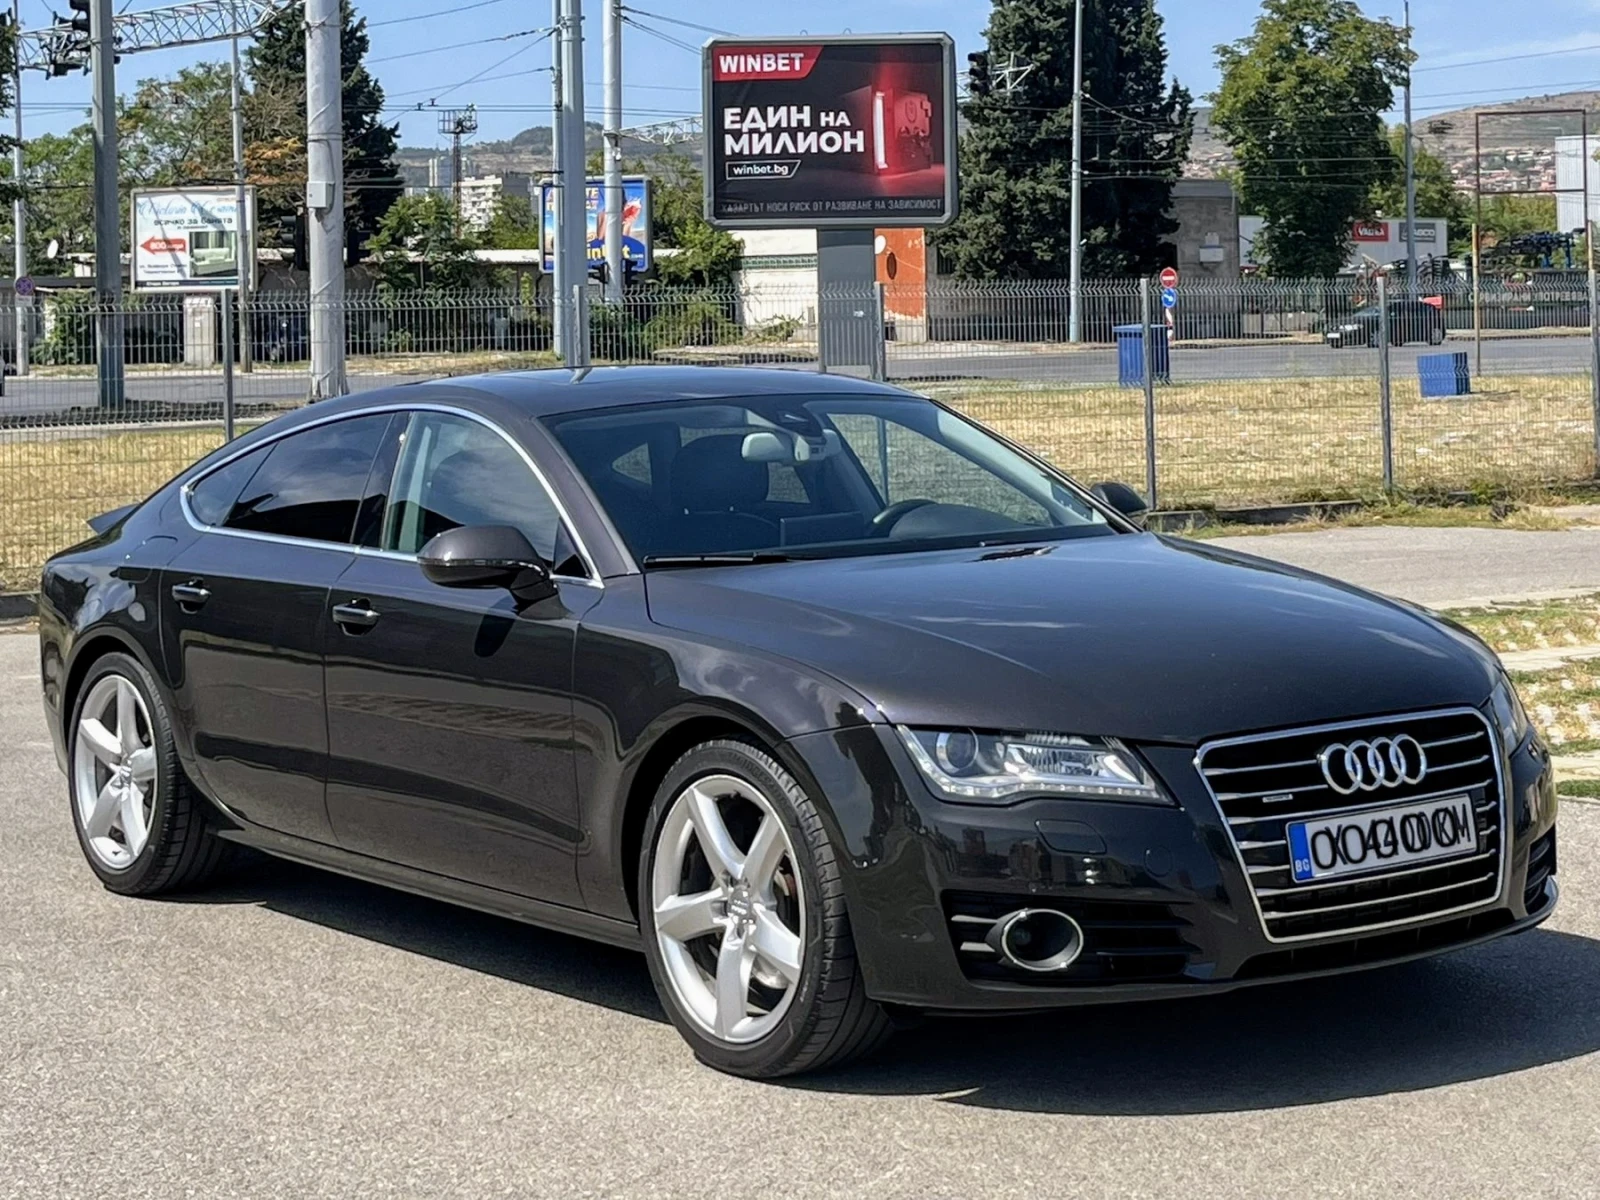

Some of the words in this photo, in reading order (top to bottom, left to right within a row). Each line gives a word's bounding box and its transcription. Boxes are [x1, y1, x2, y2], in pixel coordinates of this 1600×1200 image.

[719, 52, 804, 74] WINBET
[723, 105, 811, 133] ЕДИН
[820, 111, 851, 127] НА
[724, 130, 865, 156] МИЛИОН
[732, 164, 789, 176] winbet.bg
[766, 202, 788, 212] НОСИ
[790, 201, 810, 211] РИСК
[813, 201, 823, 211] ОТ
[825, 200, 873, 211] РАЗВИВАНЕ
[875, 199, 886, 210] НА
[888, 198, 941, 210] ЗАВИСИМОСТ
[1468, 291, 1531, 303] СРВИЗИРАНИ
[1294, 859, 1311, 873] BG
